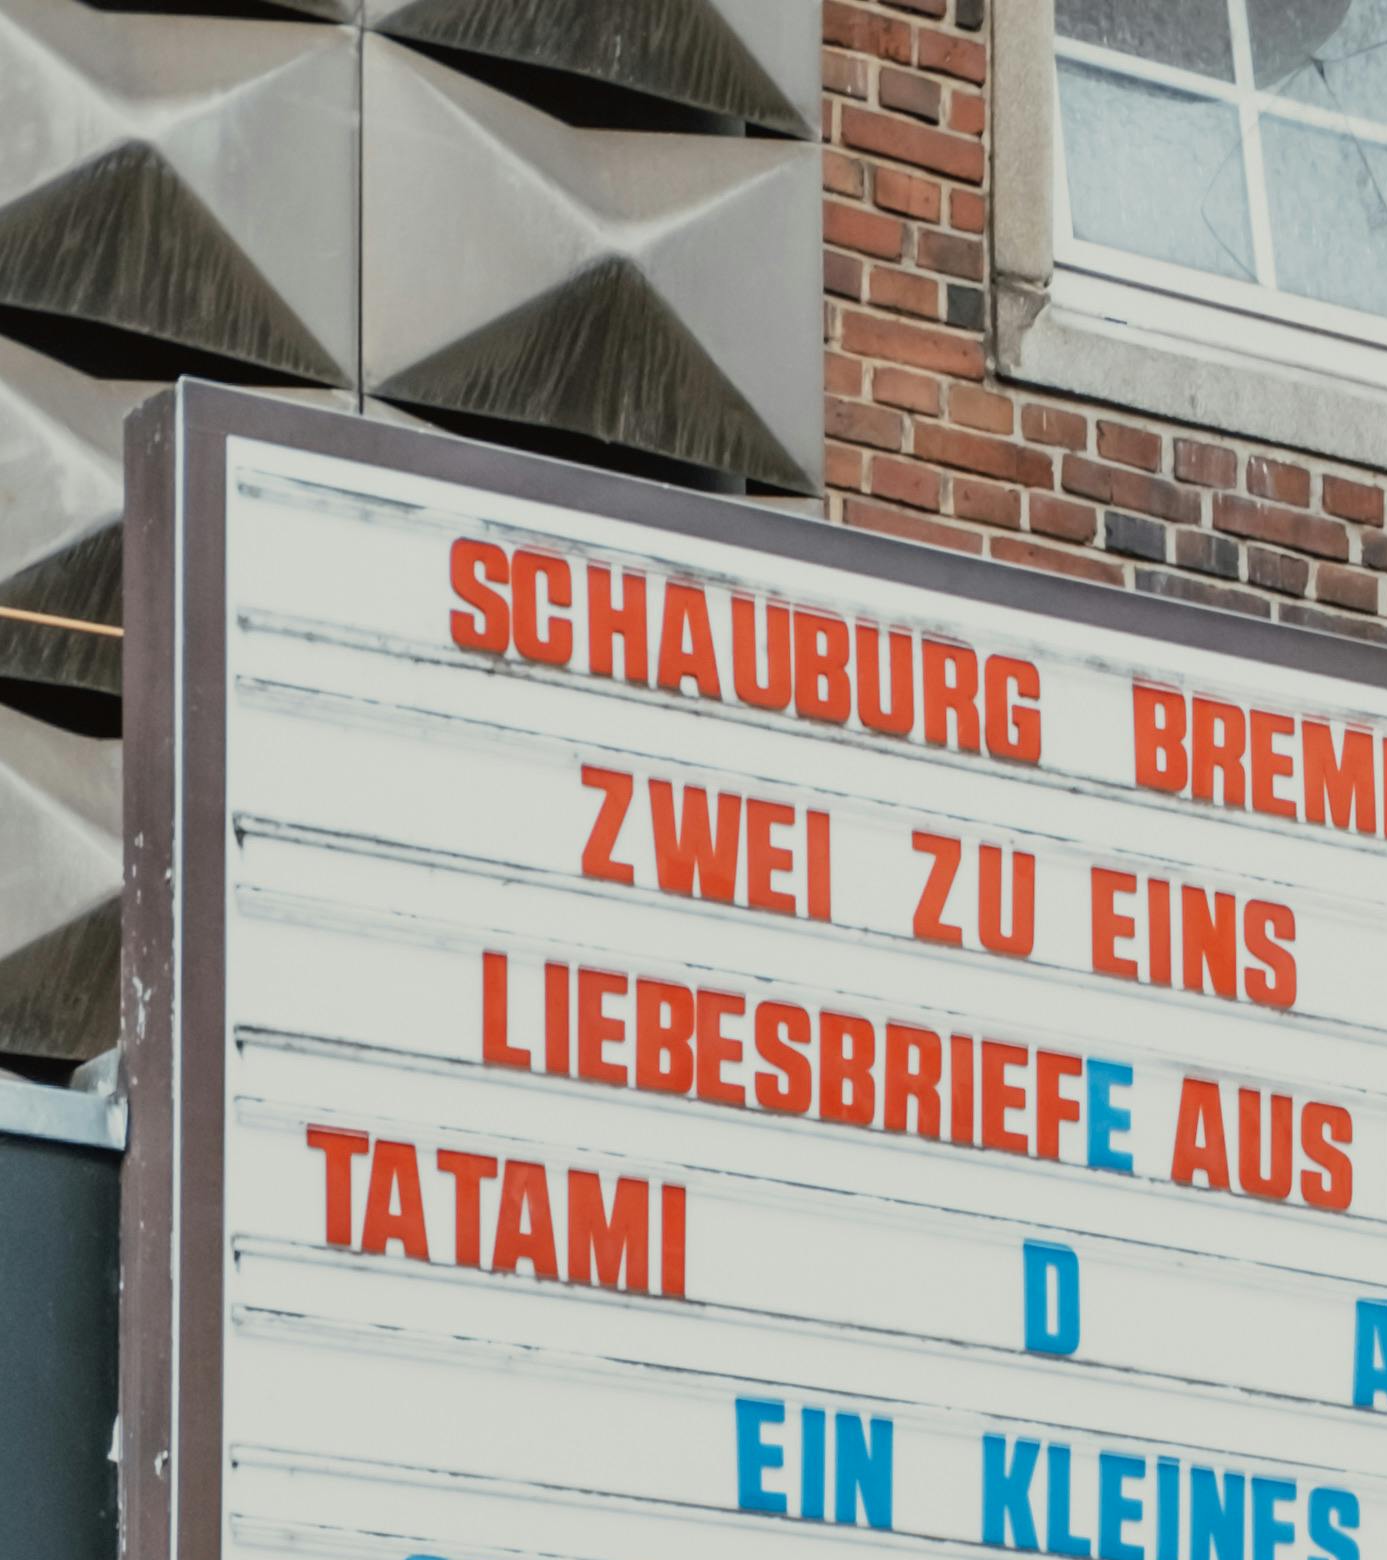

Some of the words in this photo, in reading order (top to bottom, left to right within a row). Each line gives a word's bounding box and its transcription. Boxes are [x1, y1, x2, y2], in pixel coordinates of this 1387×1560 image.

[451, 540, 1040, 762] SCHAUBURG
[582, 767, 830, 920] ZWEI
[912, 832, 1035, 956] ZU
[1092, 868, 1296, 1007] EINS
[483, 953, 1133, 1173] LIEBESBRIEFE
[1172, 1079, 1352, 1210] AUS
[307, 1129, 685, 1297] TATAMI
[1023, 1240, 1080, 1356] D
[735, 1398, 893, 1531] EIN
